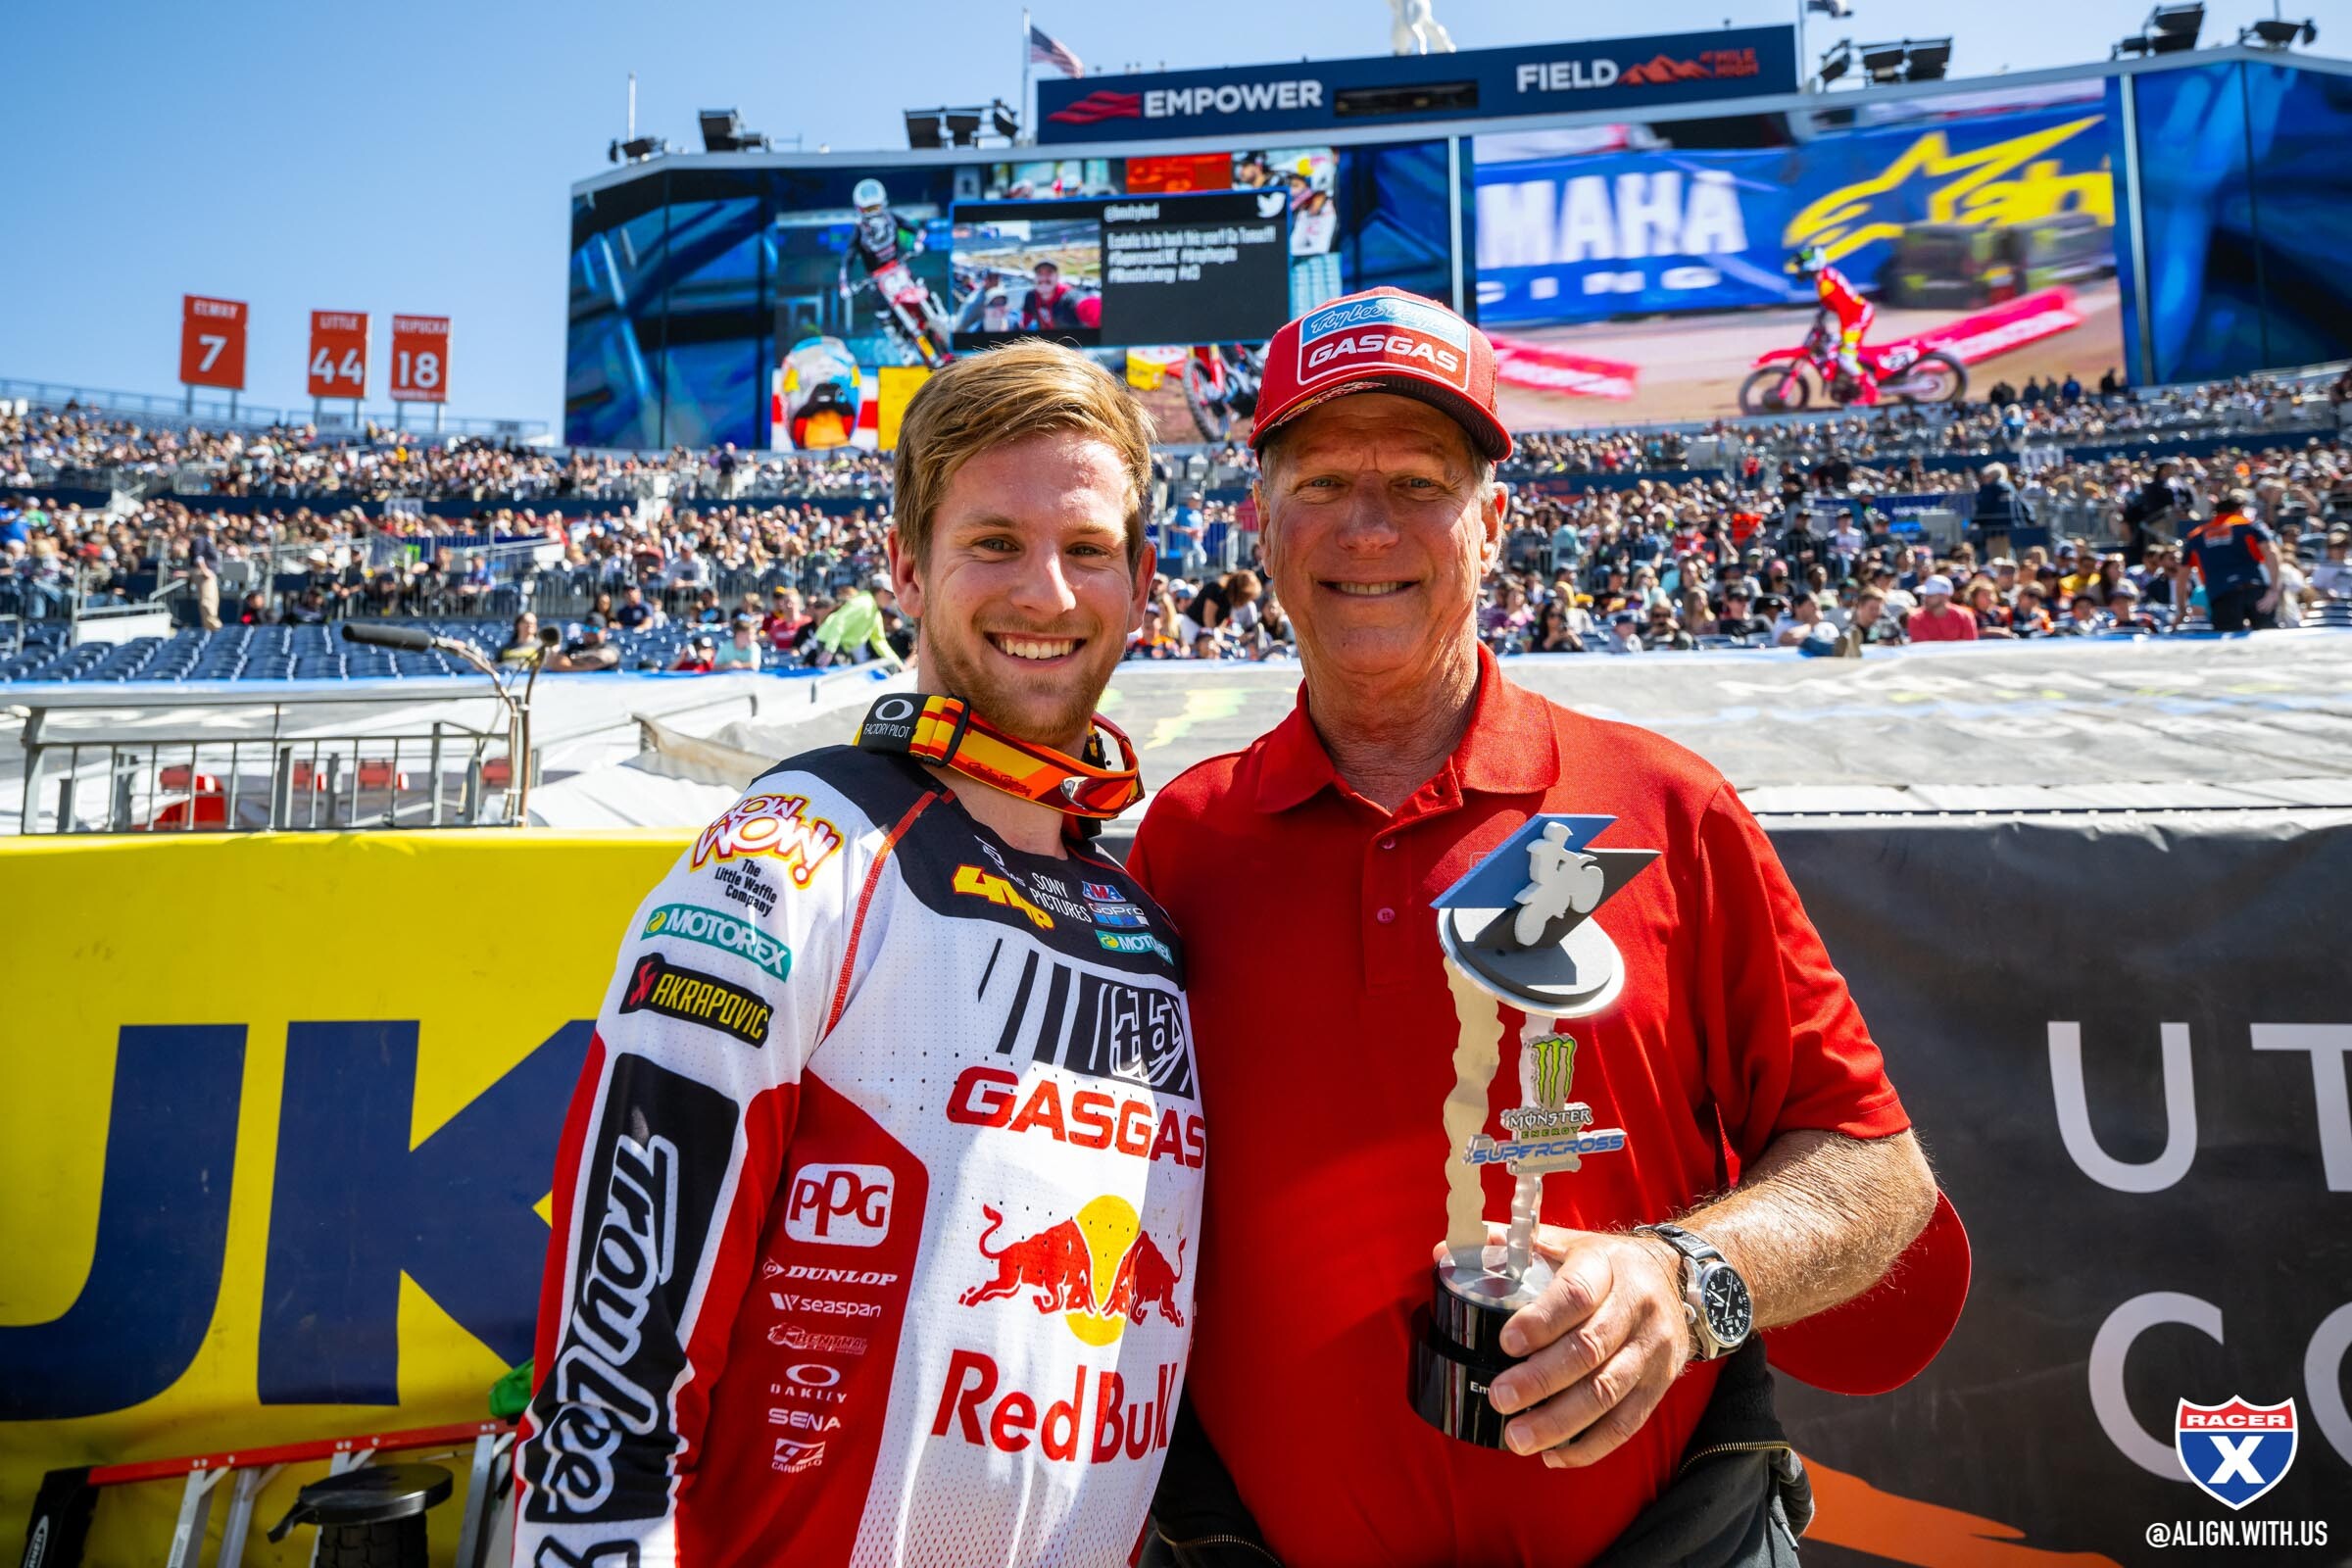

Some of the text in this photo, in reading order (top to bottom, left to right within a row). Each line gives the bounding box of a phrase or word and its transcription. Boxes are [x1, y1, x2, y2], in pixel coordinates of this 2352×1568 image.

[1516, 58, 1620, 93] FIELD
[1144, 79, 1323, 119] EMPOWER
[318, 315, 359, 331] LITTLE
[1348, 304, 1382, 323] Lee
[199, 333, 227, 372] 7
[311, 346, 365, 386] 44
[399, 350, 441, 389] 18
[1308, 334, 1458, 372] GASGAS
[863, 723, 909, 738] FACTORY PILOT
[714, 866, 777, 905] Little Waffle
[741, 858, 761, 878] The
[1031, 872, 1069, 899] SONY
[725, 884, 773, 918] Company
[1029, 887, 1094, 923] PICTURES
[1081, 881, 1125, 902] AMA
[1088, 903, 1145, 917] GoPro
[664, 907, 787, 974] MOTOREX
[946, 1065, 1206, 1169] GASGAS
[2047, 1020, 2352, 1194] UT
[1472, 1134, 1625, 1164] SUPERCROSS
[1521, 1126, 1579, 1139] ENERGY
[571, 1133, 680, 1367] Troy
[785, 1265, 899, 1286] DUNLOP
[800, 1298, 882, 1317] seaspan
[768, 1407, 841, 1432] SENA
[931, 1348, 1088, 1462] Red
[542, 1345, 660, 1515] Lee
